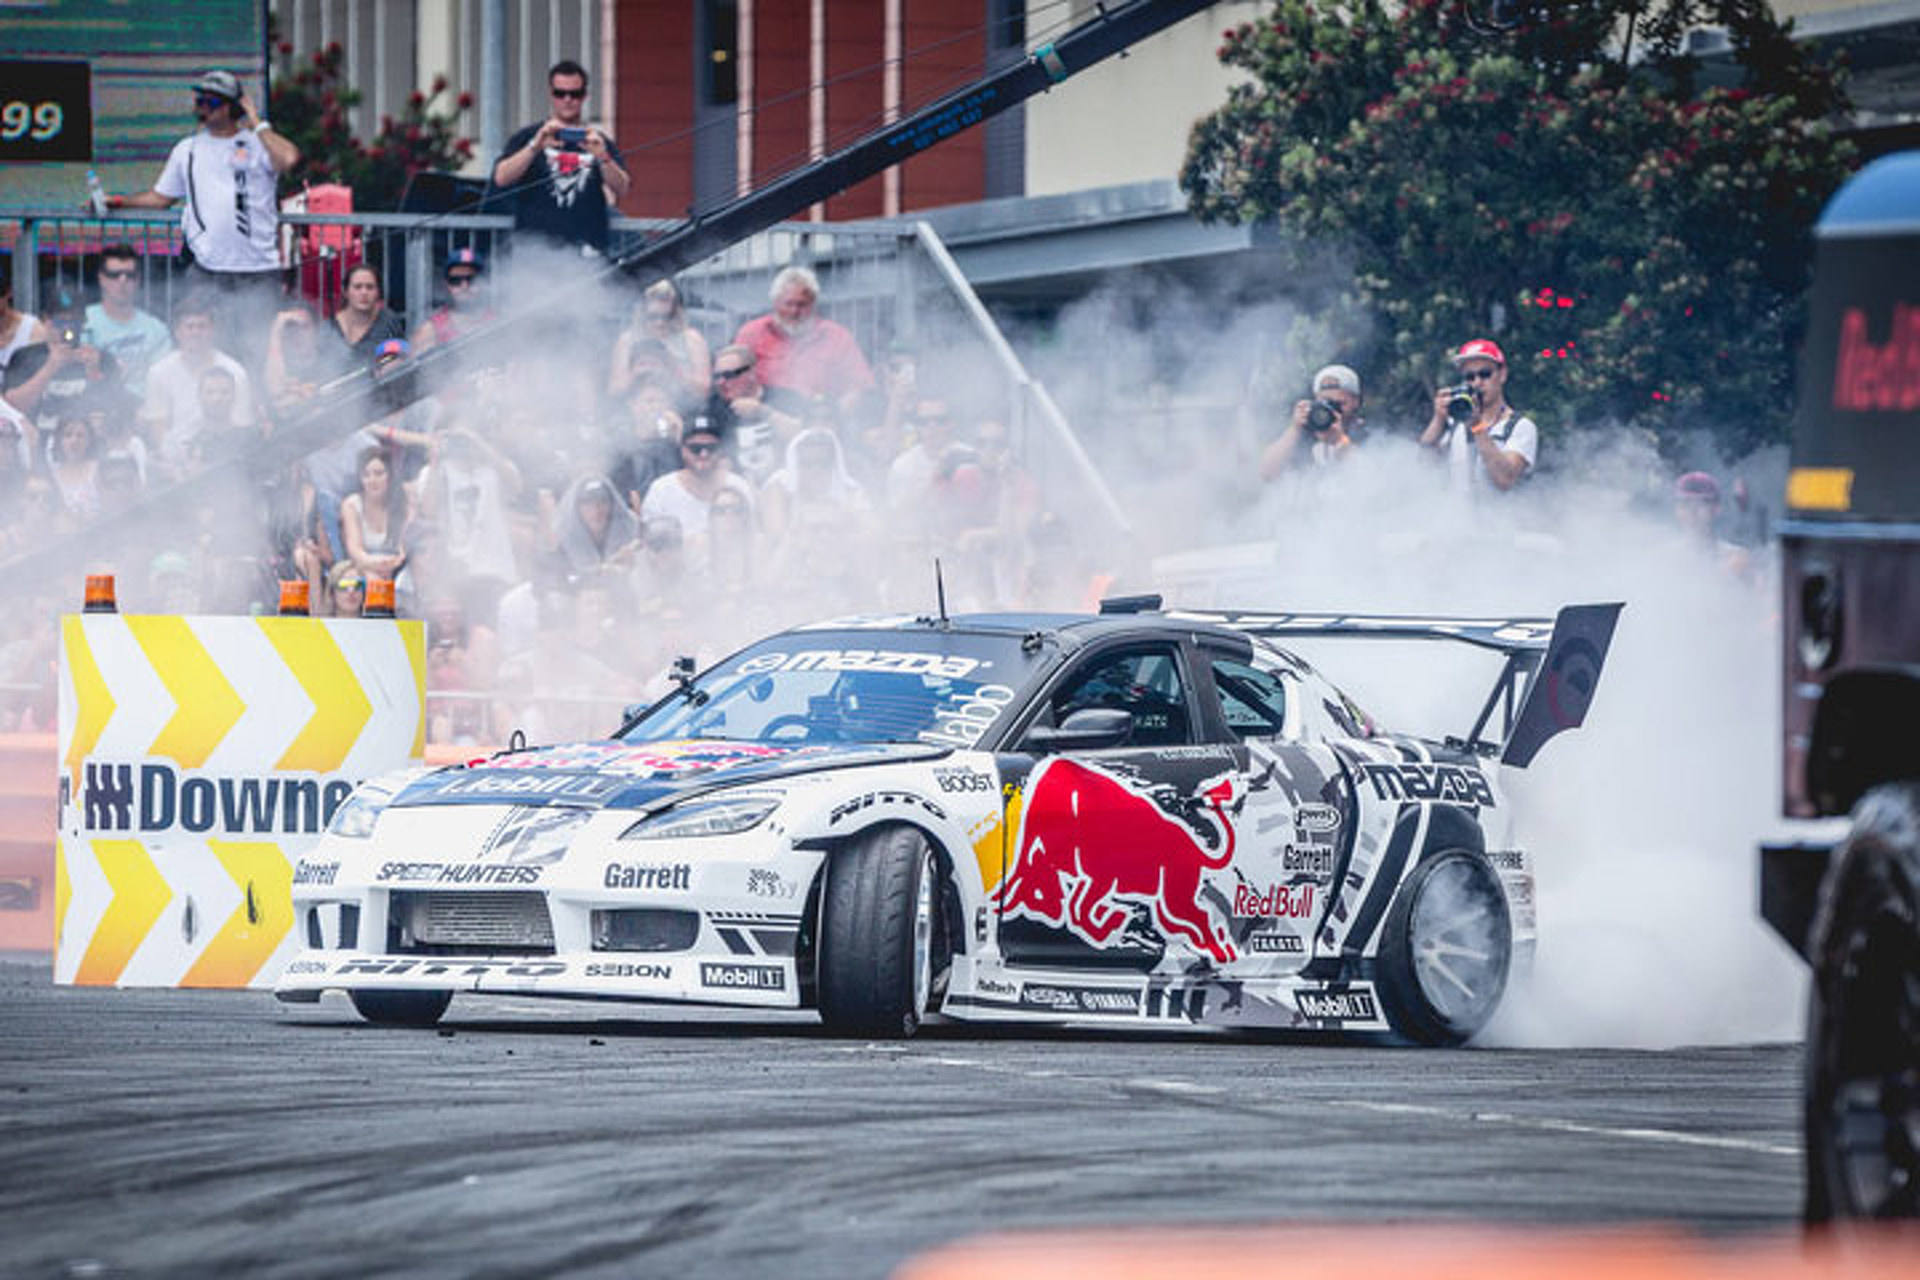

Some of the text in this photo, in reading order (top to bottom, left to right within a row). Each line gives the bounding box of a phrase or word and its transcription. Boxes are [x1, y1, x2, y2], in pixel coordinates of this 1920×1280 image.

[138, 763, 364, 833] Downe
[604, 862, 690, 891] Garrett
[1234, 883, 1313, 918] Red Bull
[585, 963, 672, 979] SEBON
[706, 968, 758, 986] Mobil
[1299, 994, 1350, 1017] Mobil
